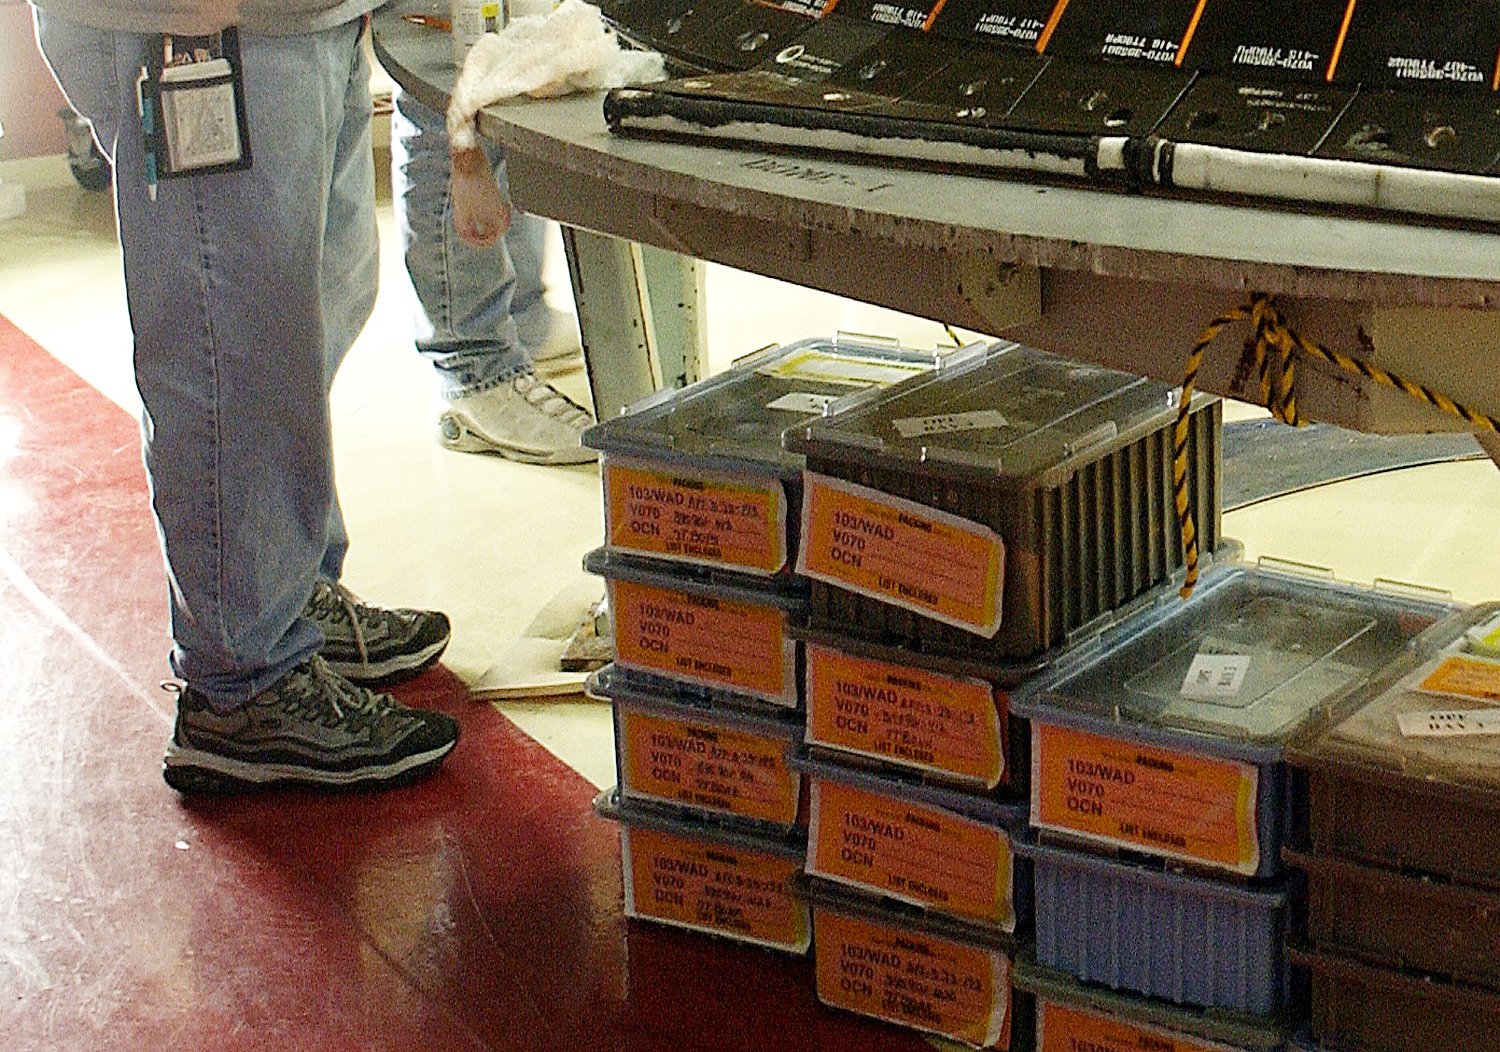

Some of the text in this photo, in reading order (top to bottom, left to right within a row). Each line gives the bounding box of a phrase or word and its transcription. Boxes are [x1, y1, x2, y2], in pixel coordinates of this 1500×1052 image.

[833, 529, 866, 549] V070
[831, 548, 862, 567] OCN
[836, 697, 869, 716] V070
[1067, 759, 1135, 785] 103/WAD
[1067, 778, 1104, 797] V070
[1067, 797, 1102, 816] OCN
